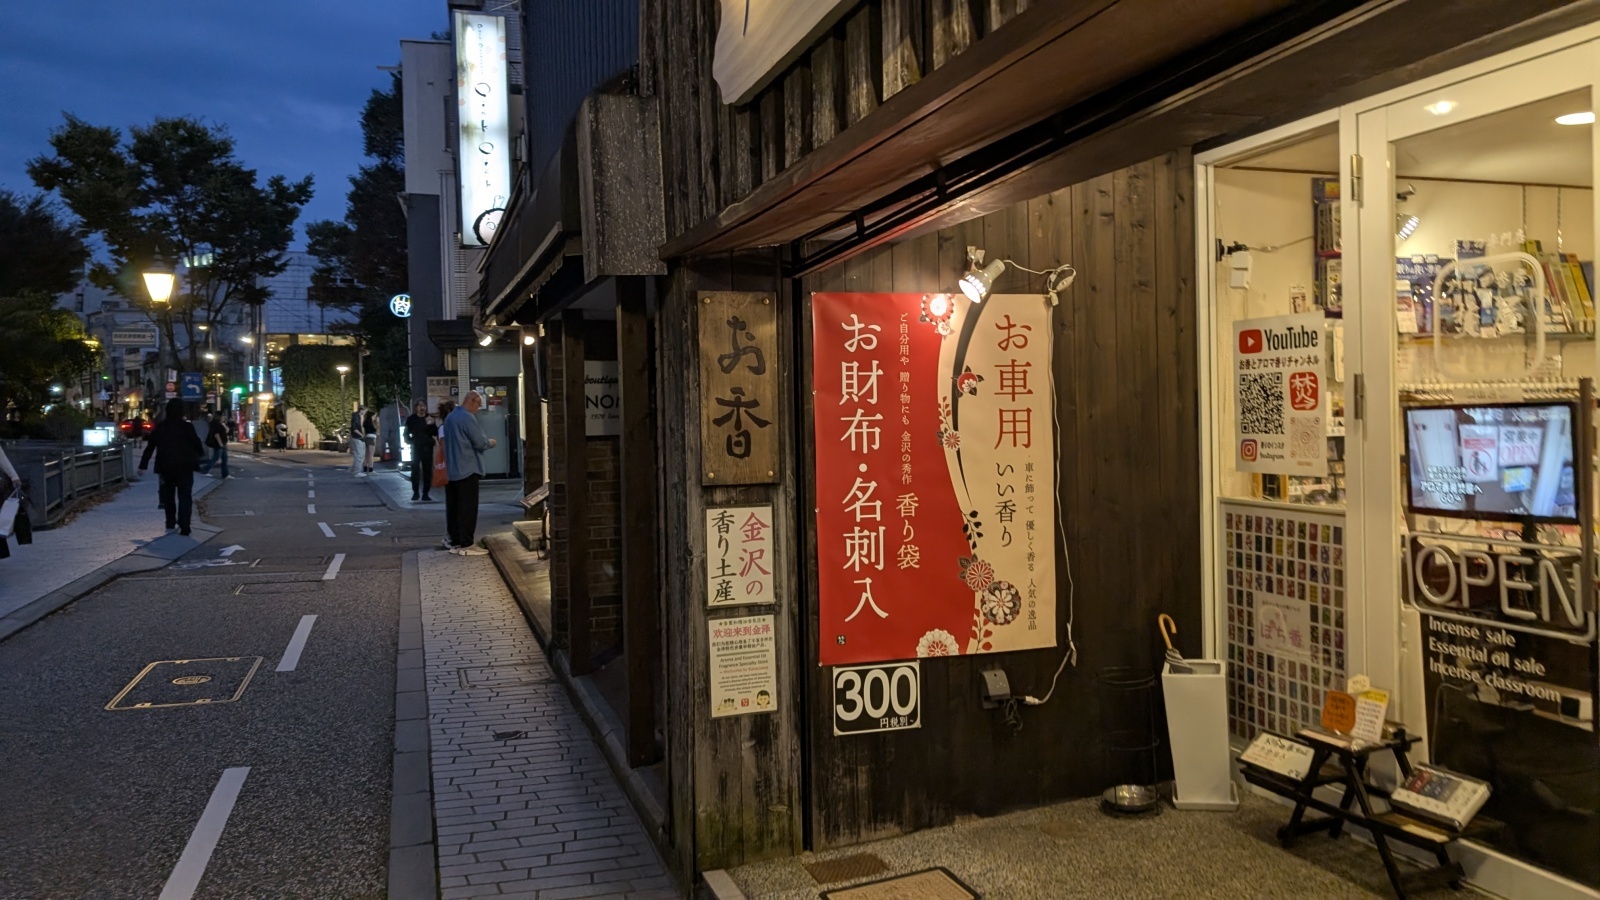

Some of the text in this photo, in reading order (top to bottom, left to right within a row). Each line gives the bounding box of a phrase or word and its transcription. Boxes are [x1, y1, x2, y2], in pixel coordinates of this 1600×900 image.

[1264, 325, 1319, 351] YouTube
[712, 315, 772, 459] お香
[838, 313, 889, 623] お財布・名刺入
[896, 312, 921, 570] ご自分用や 贈り物にも 金沢の秀作 香り袋
[994, 314, 1034, 548] お車用 いい香り
[710, 509, 737, 603] 香り土産
[739, 511, 771, 596] 金沢の
[1025, 462, 1038, 631] 車に飾って 優しく香る 人気の逸品
[1415, 544, 1585, 628] OPEN
[712, 624, 771, 639] 欢迎来到金泽
[1429, 616, 1517, 648] Incense sale
[1429, 636, 1546, 676] Essential oil sale
[836, 666, 917, 721] 300
[1429, 656, 1562, 703] Incense classroom
